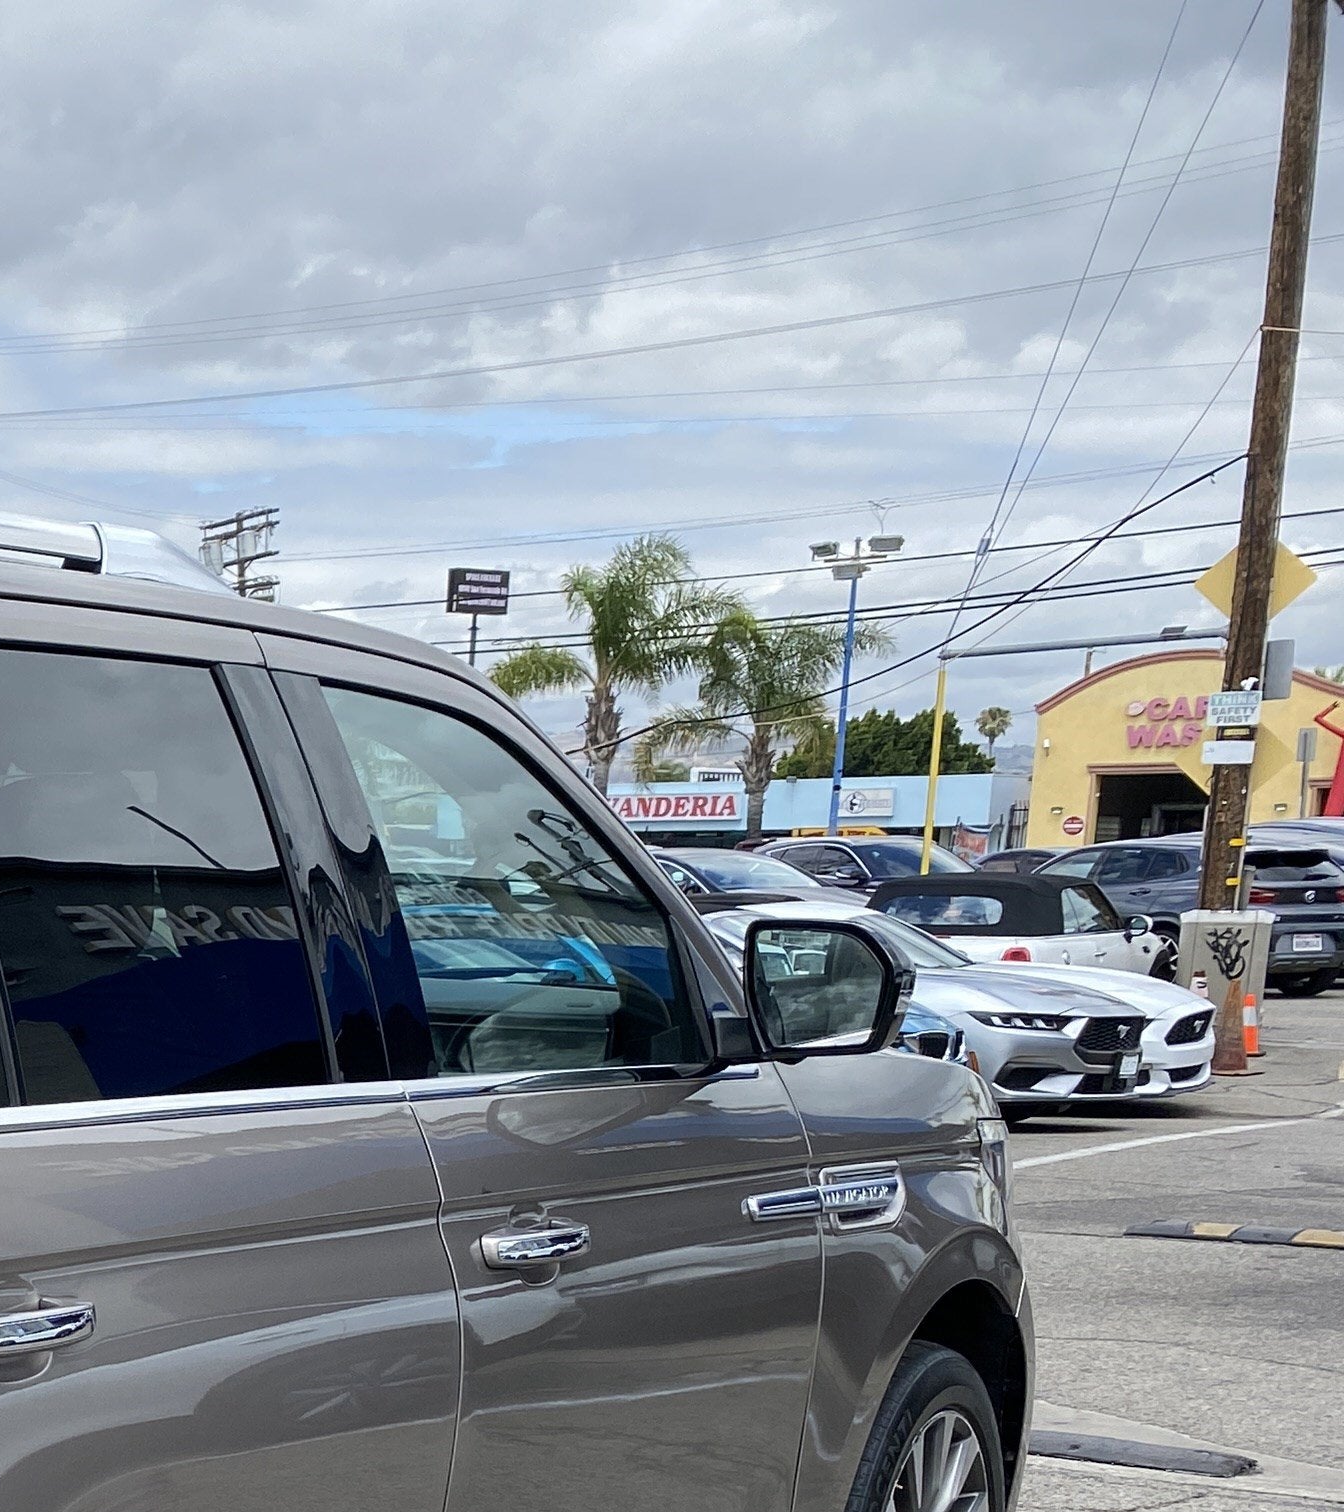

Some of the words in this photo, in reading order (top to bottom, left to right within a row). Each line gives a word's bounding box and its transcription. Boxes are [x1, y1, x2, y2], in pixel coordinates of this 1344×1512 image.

[1211, 693, 1260, 706] THINK
[1212, 706, 1257, 716] SAFETY
[1216, 715, 1251, 724] FIRST
[1126, 723, 1202, 748] WAS
